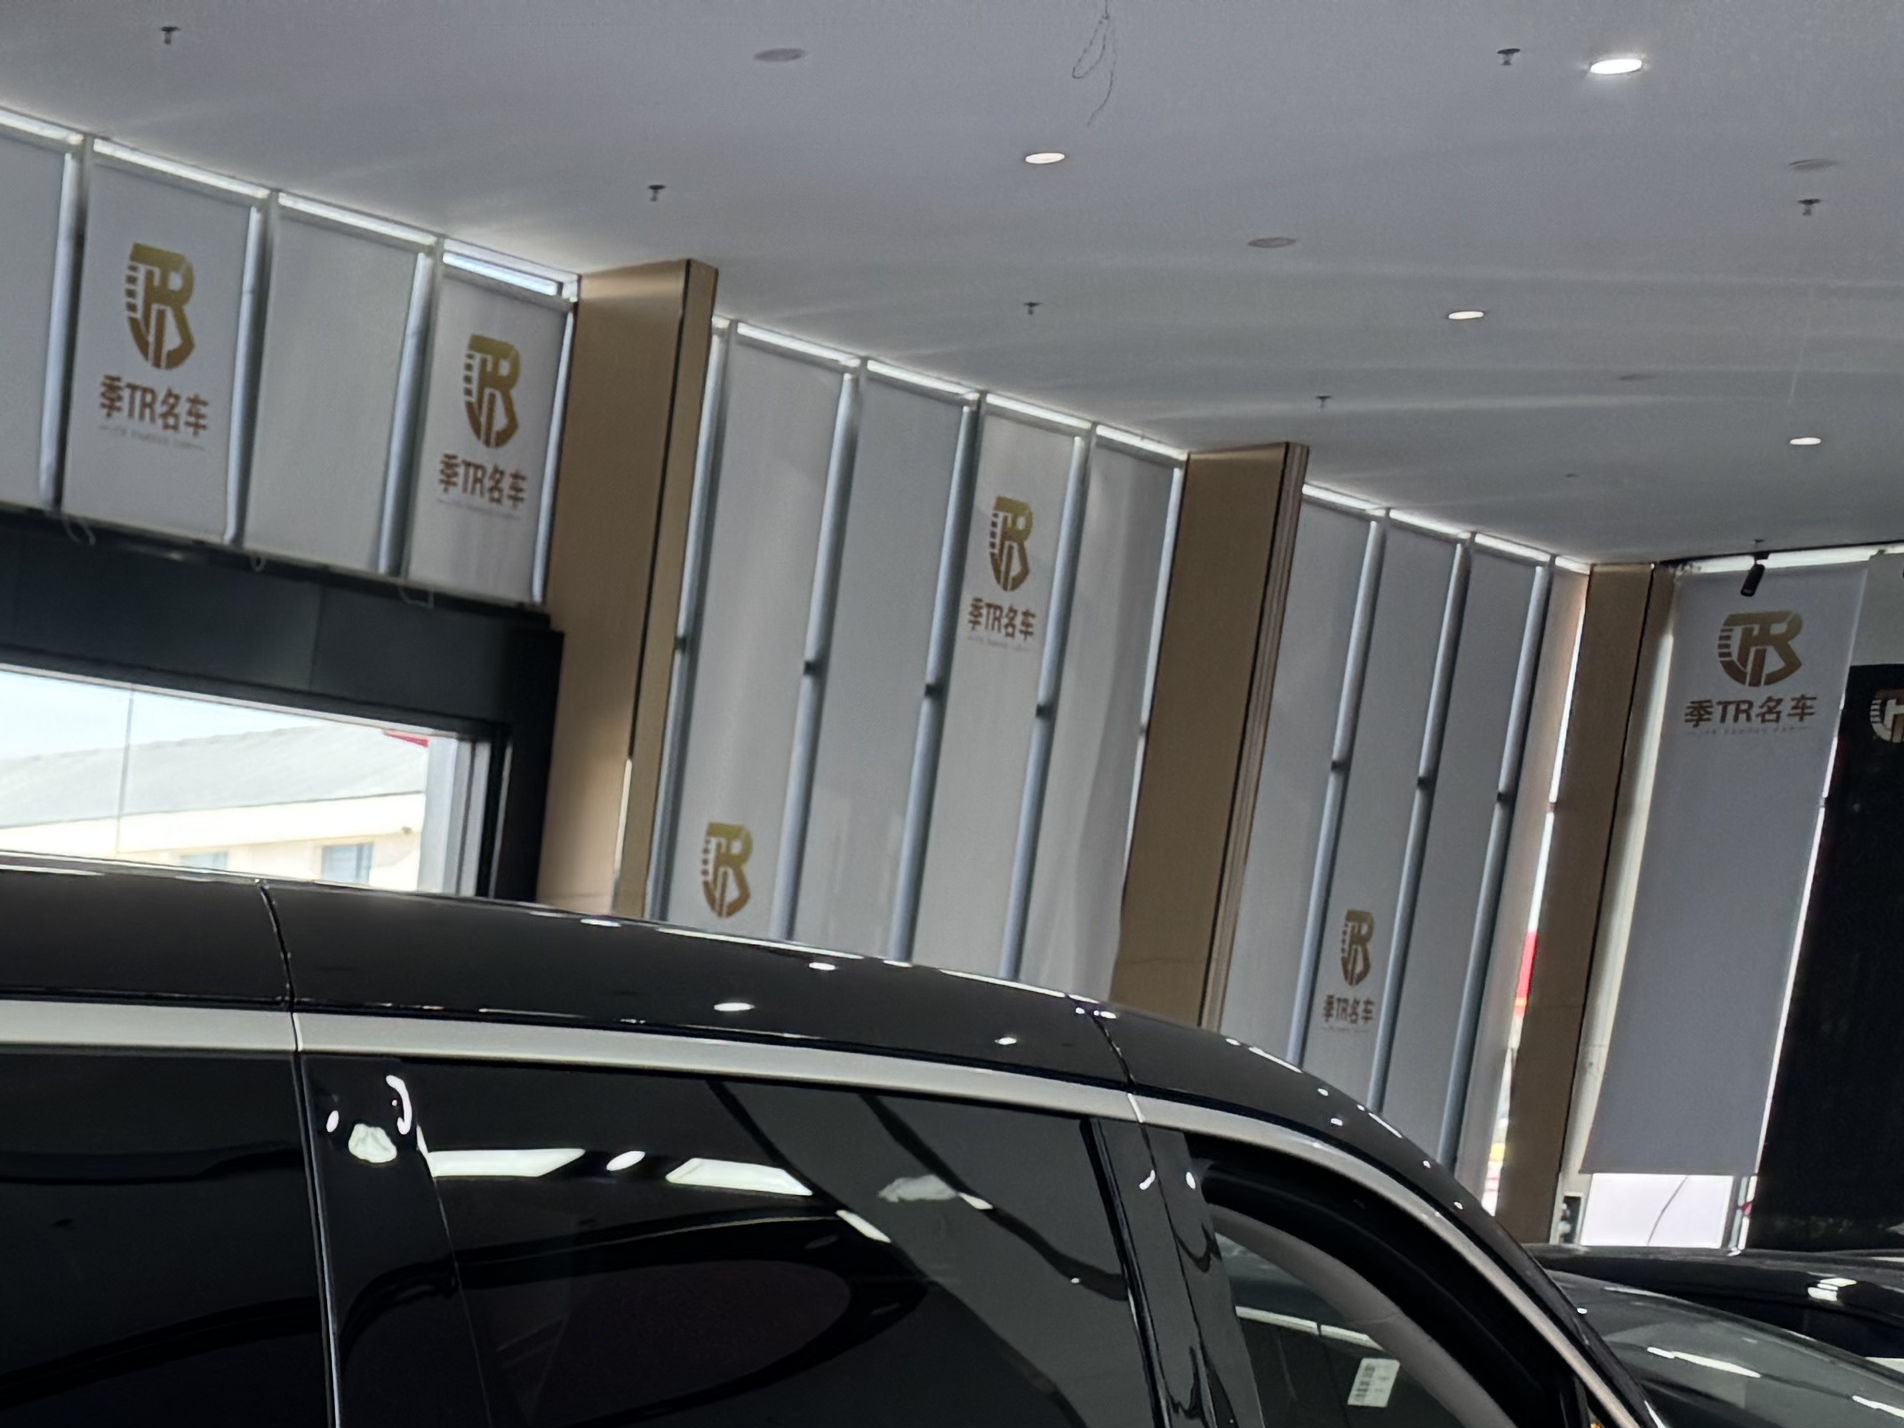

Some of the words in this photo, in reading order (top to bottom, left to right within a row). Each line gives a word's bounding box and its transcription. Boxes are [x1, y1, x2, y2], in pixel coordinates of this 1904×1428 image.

[99, 373, 211, 438] 季TR名车
[1684, 694, 1818, 728] 季TR名车
